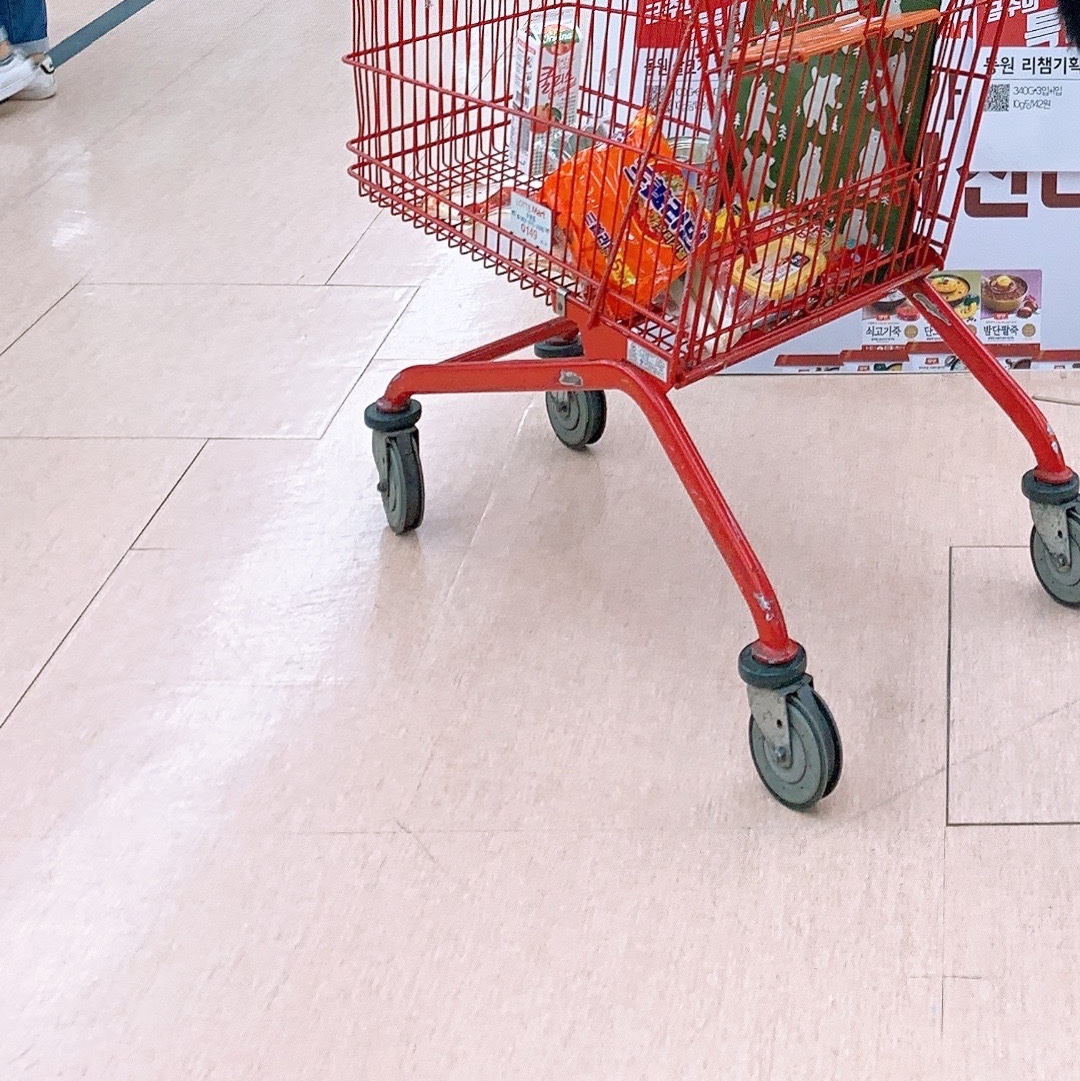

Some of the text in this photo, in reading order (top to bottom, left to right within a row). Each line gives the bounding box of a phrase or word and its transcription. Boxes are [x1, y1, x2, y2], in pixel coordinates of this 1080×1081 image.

[983, 56, 1015, 76] 동원
[865, 326, 901, 338] 쇠고기죽
[983, 324, 1019, 337] 밤단팥죽
